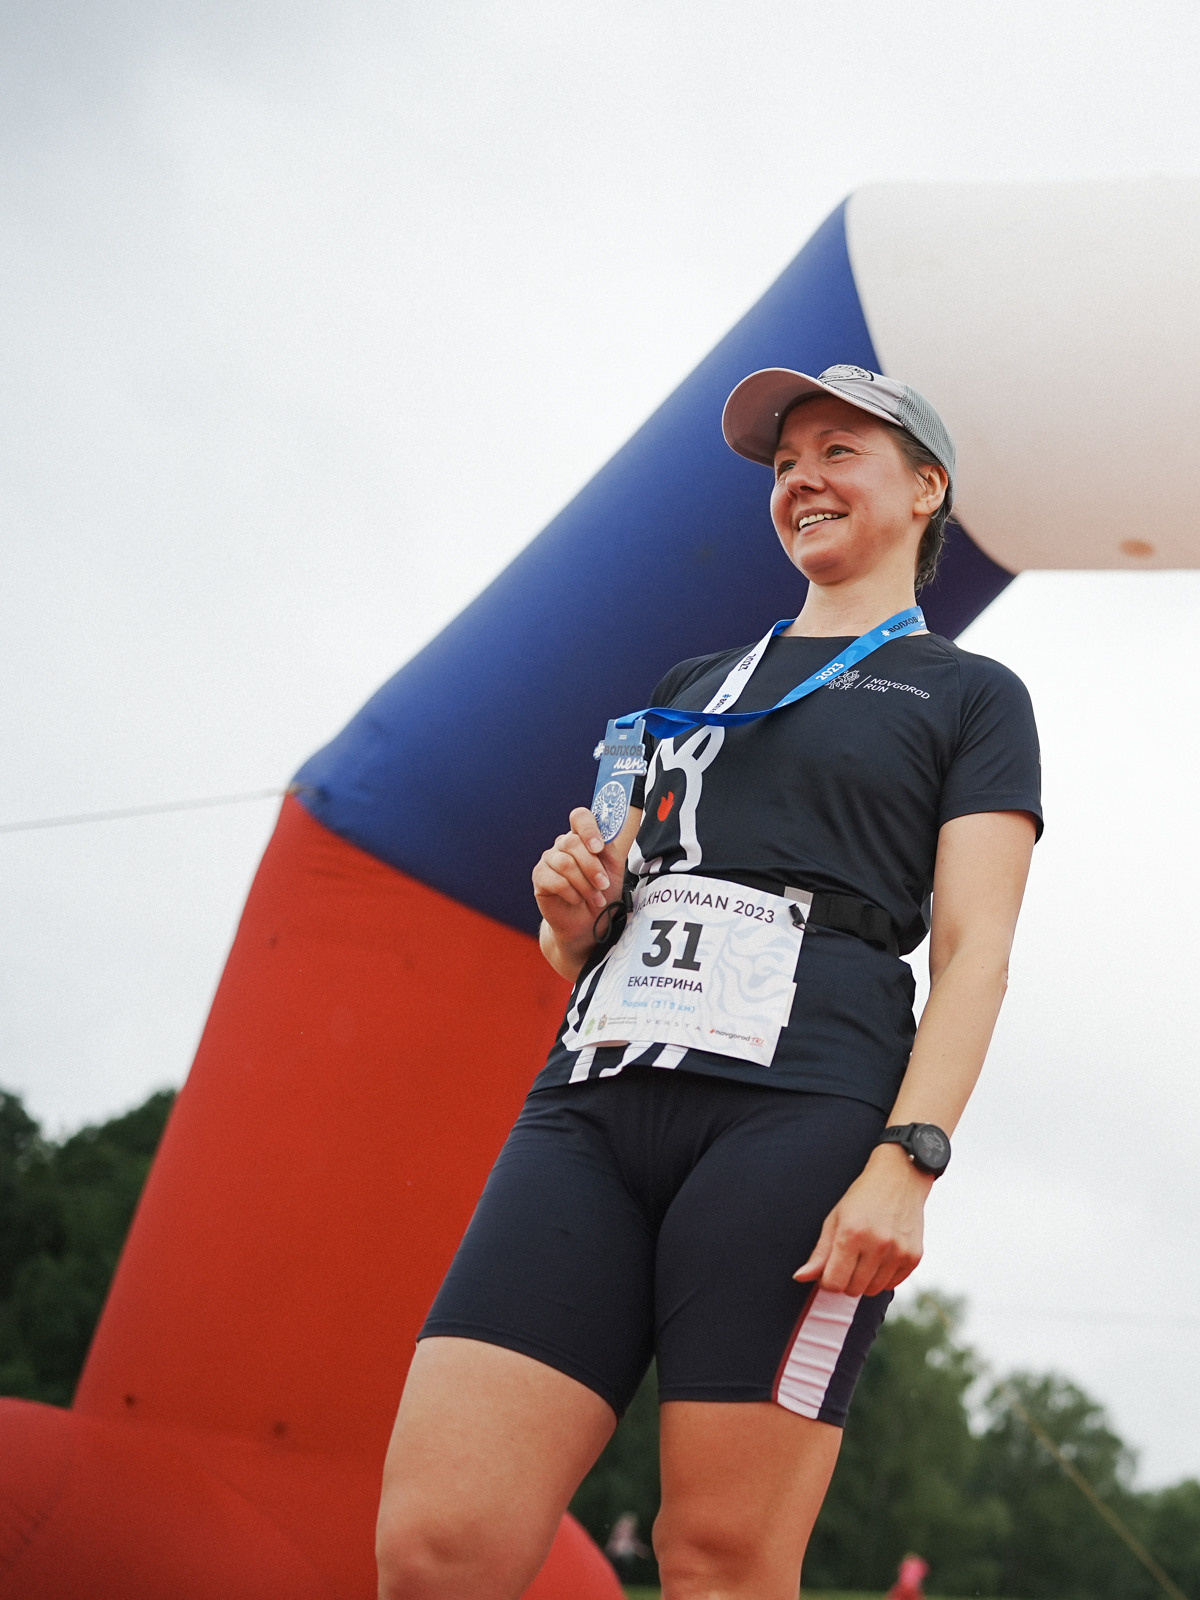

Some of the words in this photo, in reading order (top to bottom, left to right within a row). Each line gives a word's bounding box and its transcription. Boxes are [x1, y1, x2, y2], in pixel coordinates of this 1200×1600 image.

[815, 662, 845, 681] 2023
[863, 683, 889, 693] RUN
[870, 678, 931, 700] NOVGOROD
[732, 900, 775, 923] 2023
[642, 920, 703, 972] 31
[627, 975, 703, 993] ЕКАТЕРИНА
